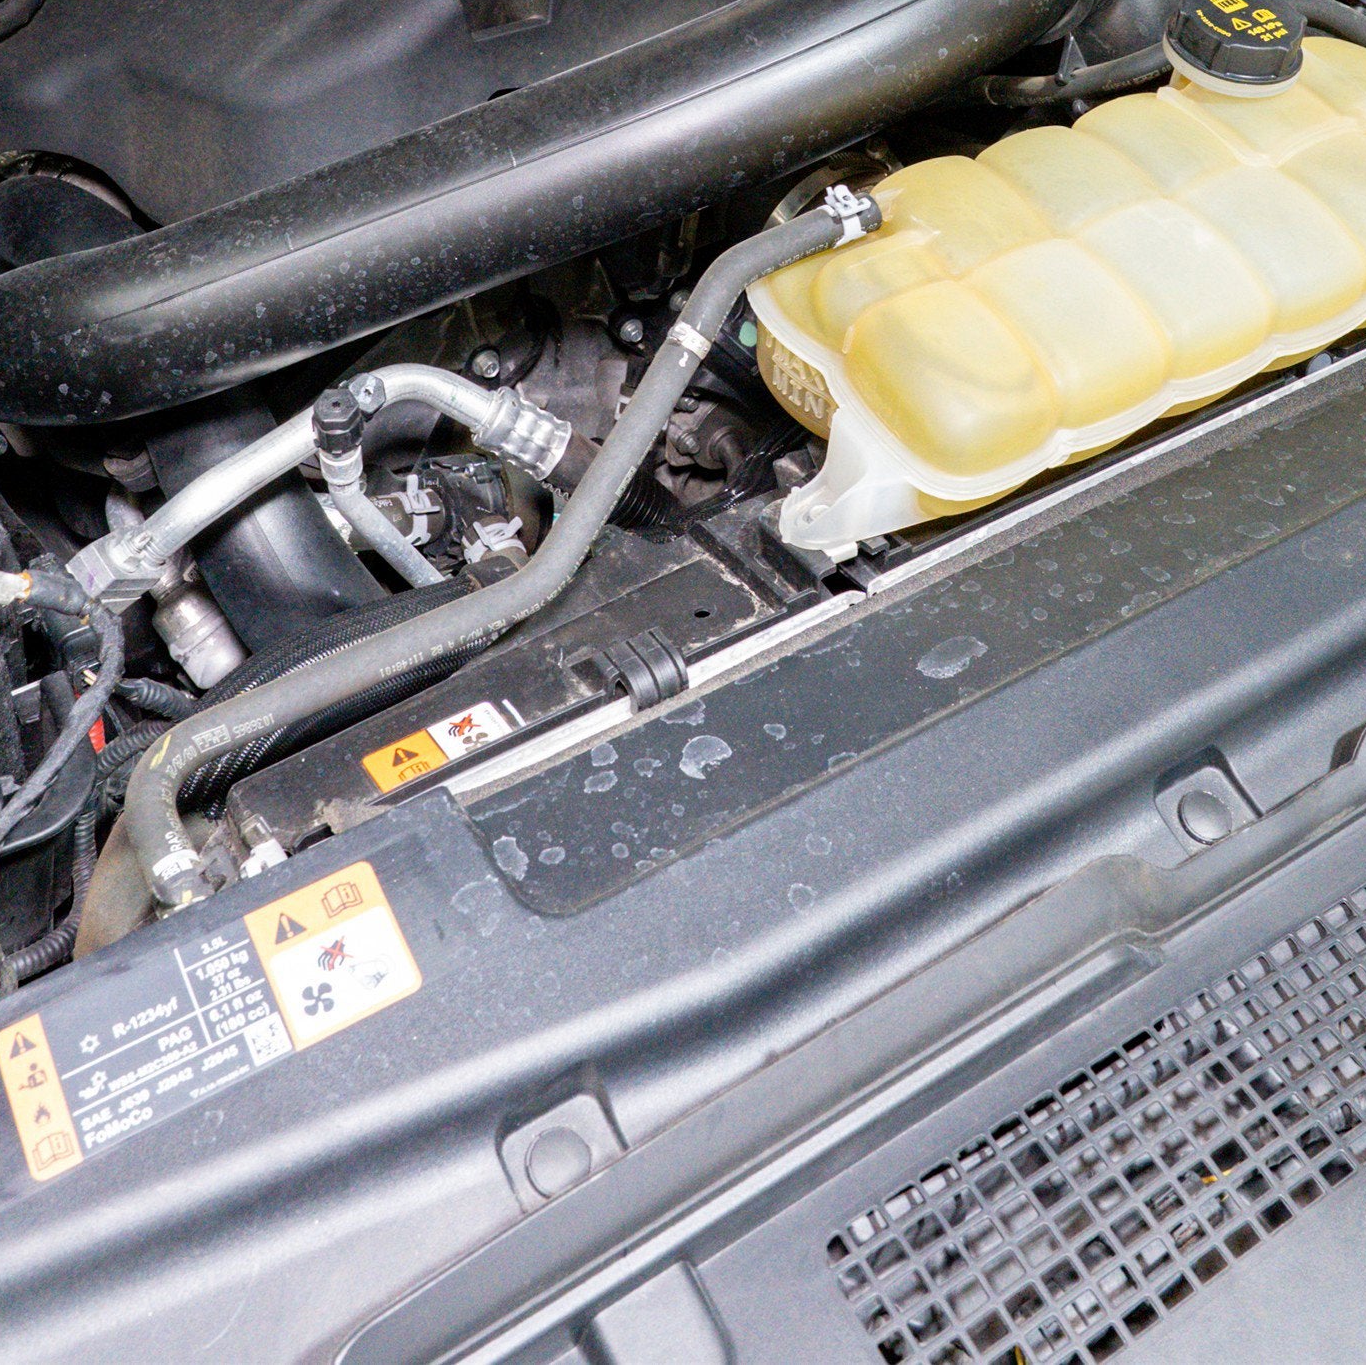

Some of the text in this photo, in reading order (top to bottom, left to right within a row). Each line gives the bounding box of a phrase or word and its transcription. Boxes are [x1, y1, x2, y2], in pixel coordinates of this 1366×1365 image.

[772, 364, 825, 420] MIN
[165, 831, 183, 852] RAD
[230, 948, 248, 966] kg
[212, 966, 240, 986] 37 oz
[233, 974, 250, 989] lbs
[245, 989, 263, 1005] oz
[112, 996, 178, 1039] R-1234yf
[158, 1025, 192, 1051] PAG
[80, 1107, 112, 1131] SAE
[83, 1106, 153, 1146] FoMoCo
